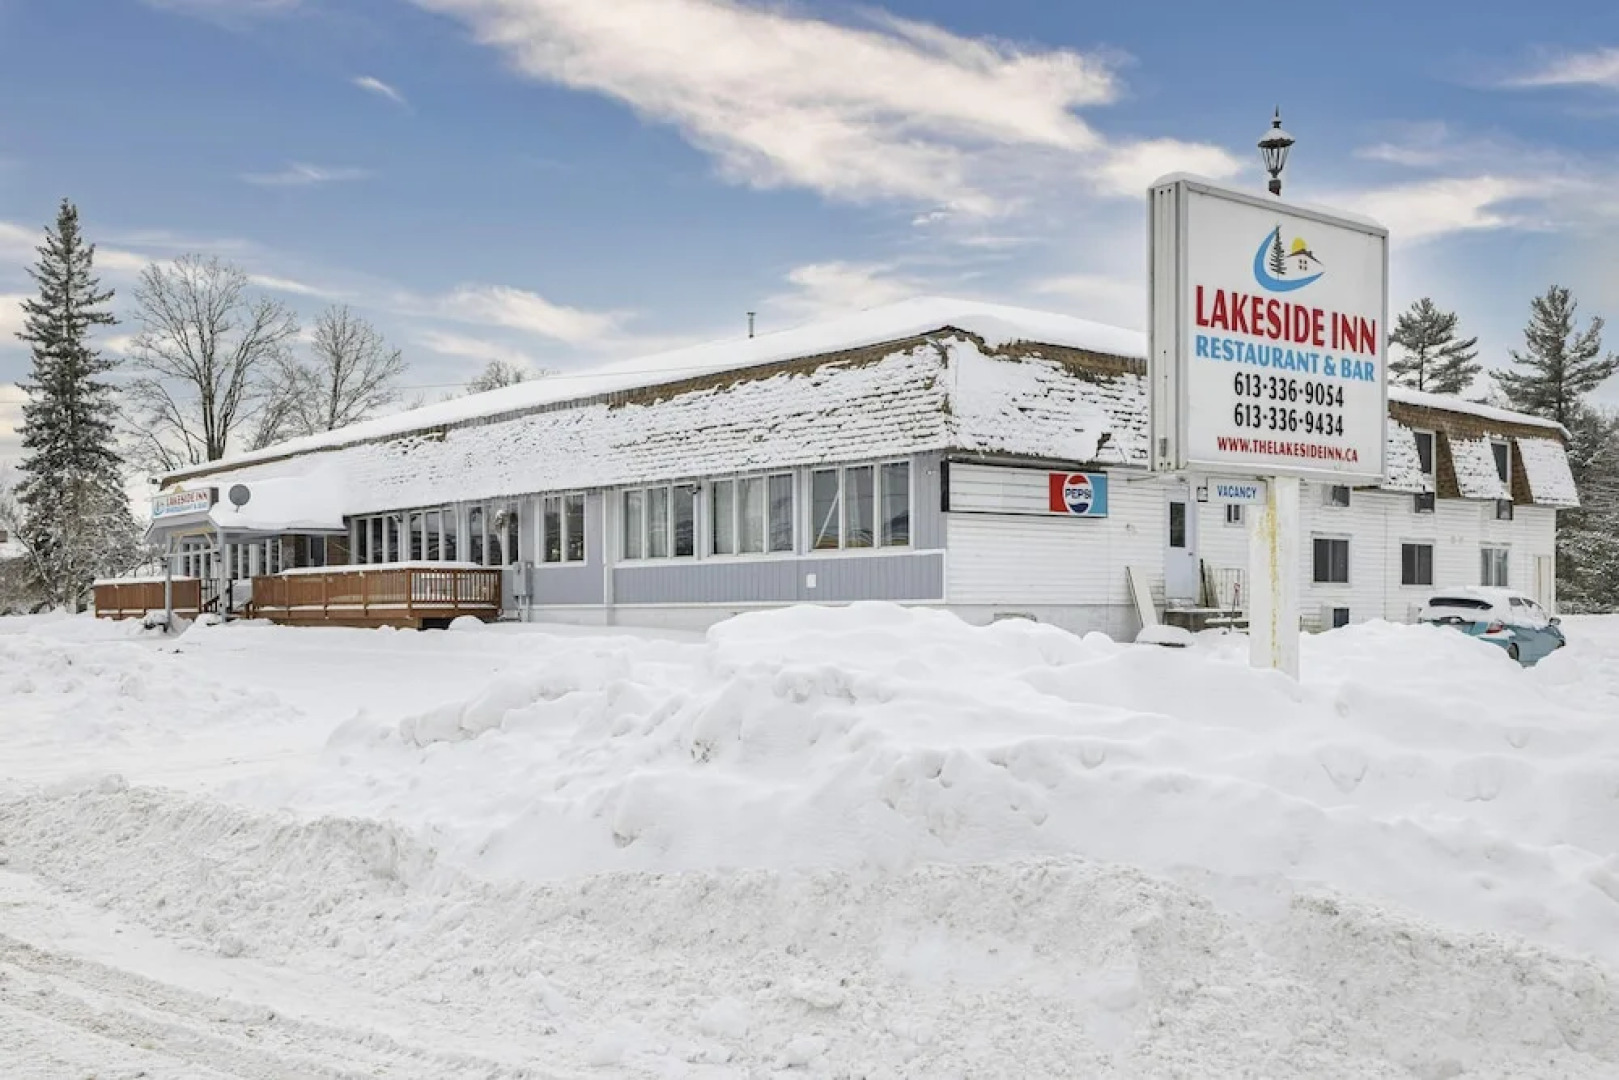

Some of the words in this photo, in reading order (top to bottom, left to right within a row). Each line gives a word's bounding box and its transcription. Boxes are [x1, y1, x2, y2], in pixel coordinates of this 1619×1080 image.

[1195, 285, 1324, 347] LAKESIDE
[1332, 312, 1376, 356] INN
[1195, 334, 1319, 374] RESTAURANT
[1324, 356, 1336, 377] &
[1341, 359, 1376, 382] BAR
[1217, 437, 1358, 462] WWW.THELAKESIDEINN.CA
[1065, 488, 1092, 500] PEPSI
[1217, 485, 1257, 499] VACANCY
